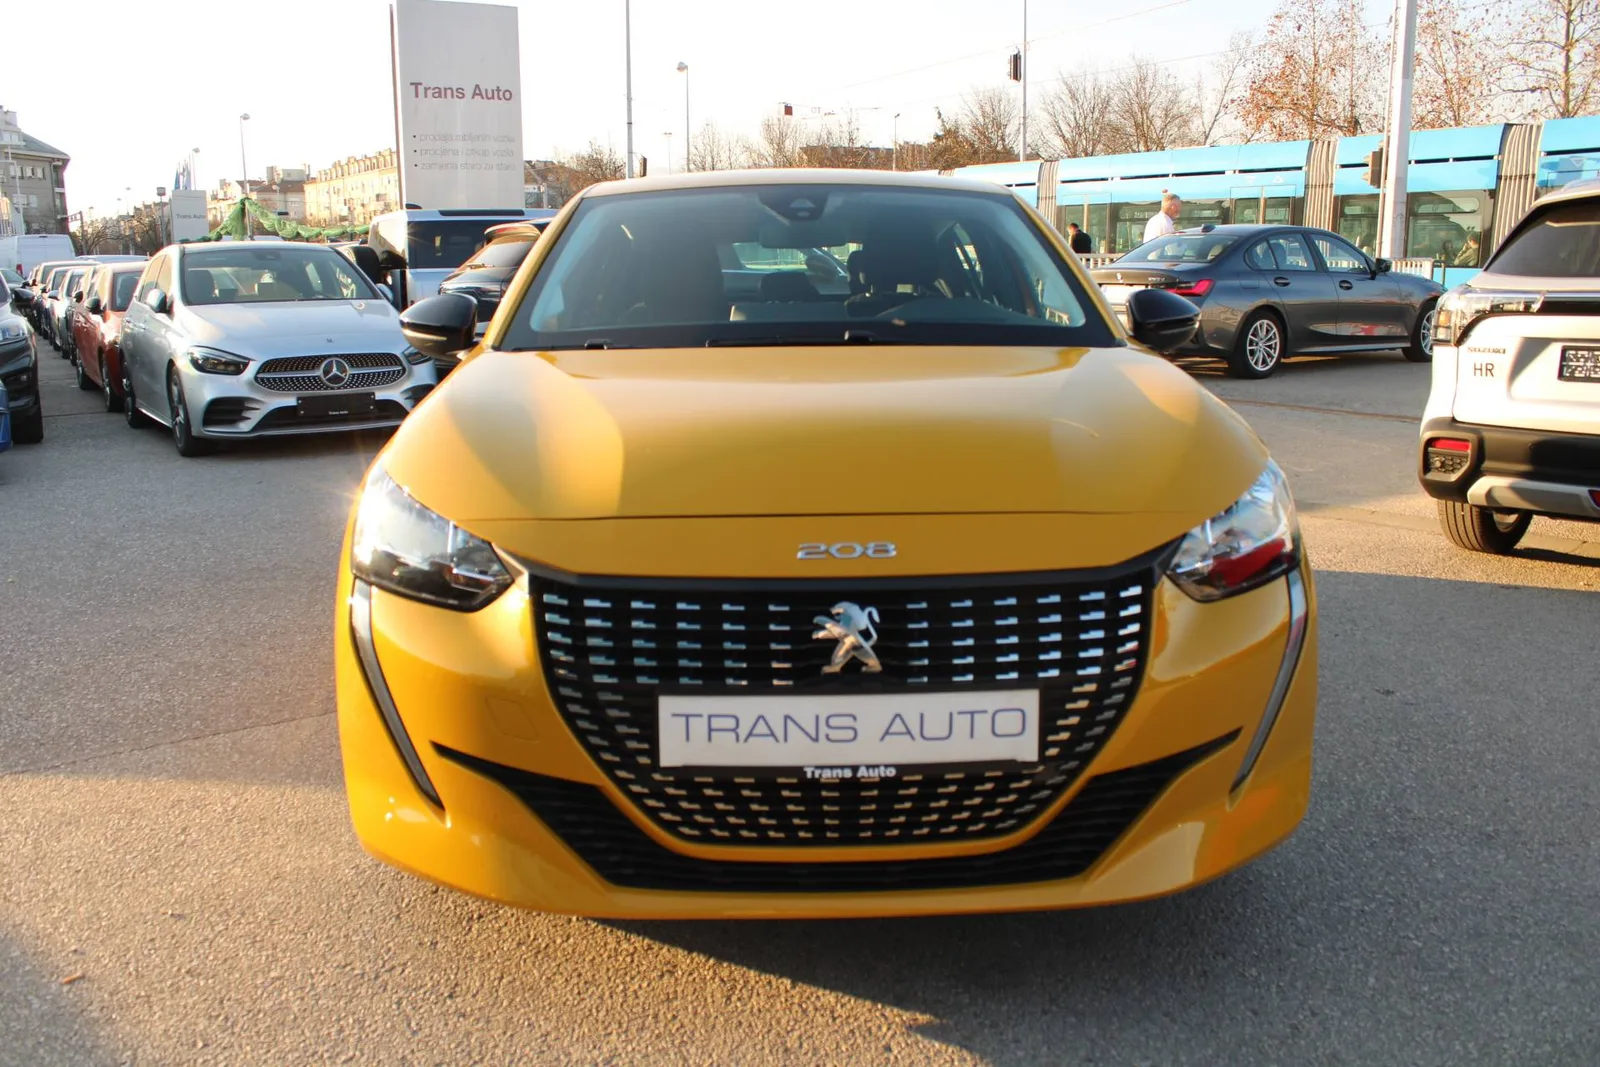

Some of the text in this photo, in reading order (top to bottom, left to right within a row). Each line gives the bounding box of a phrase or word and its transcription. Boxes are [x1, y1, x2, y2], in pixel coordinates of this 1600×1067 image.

[410, 82, 513, 101] Trans Auto
[1473, 362, 1495, 377] HR
[797, 541, 897, 560] 208
[671, 707, 1028, 744] TRANS AUTO
[803, 765, 897, 779] Trans Auto
